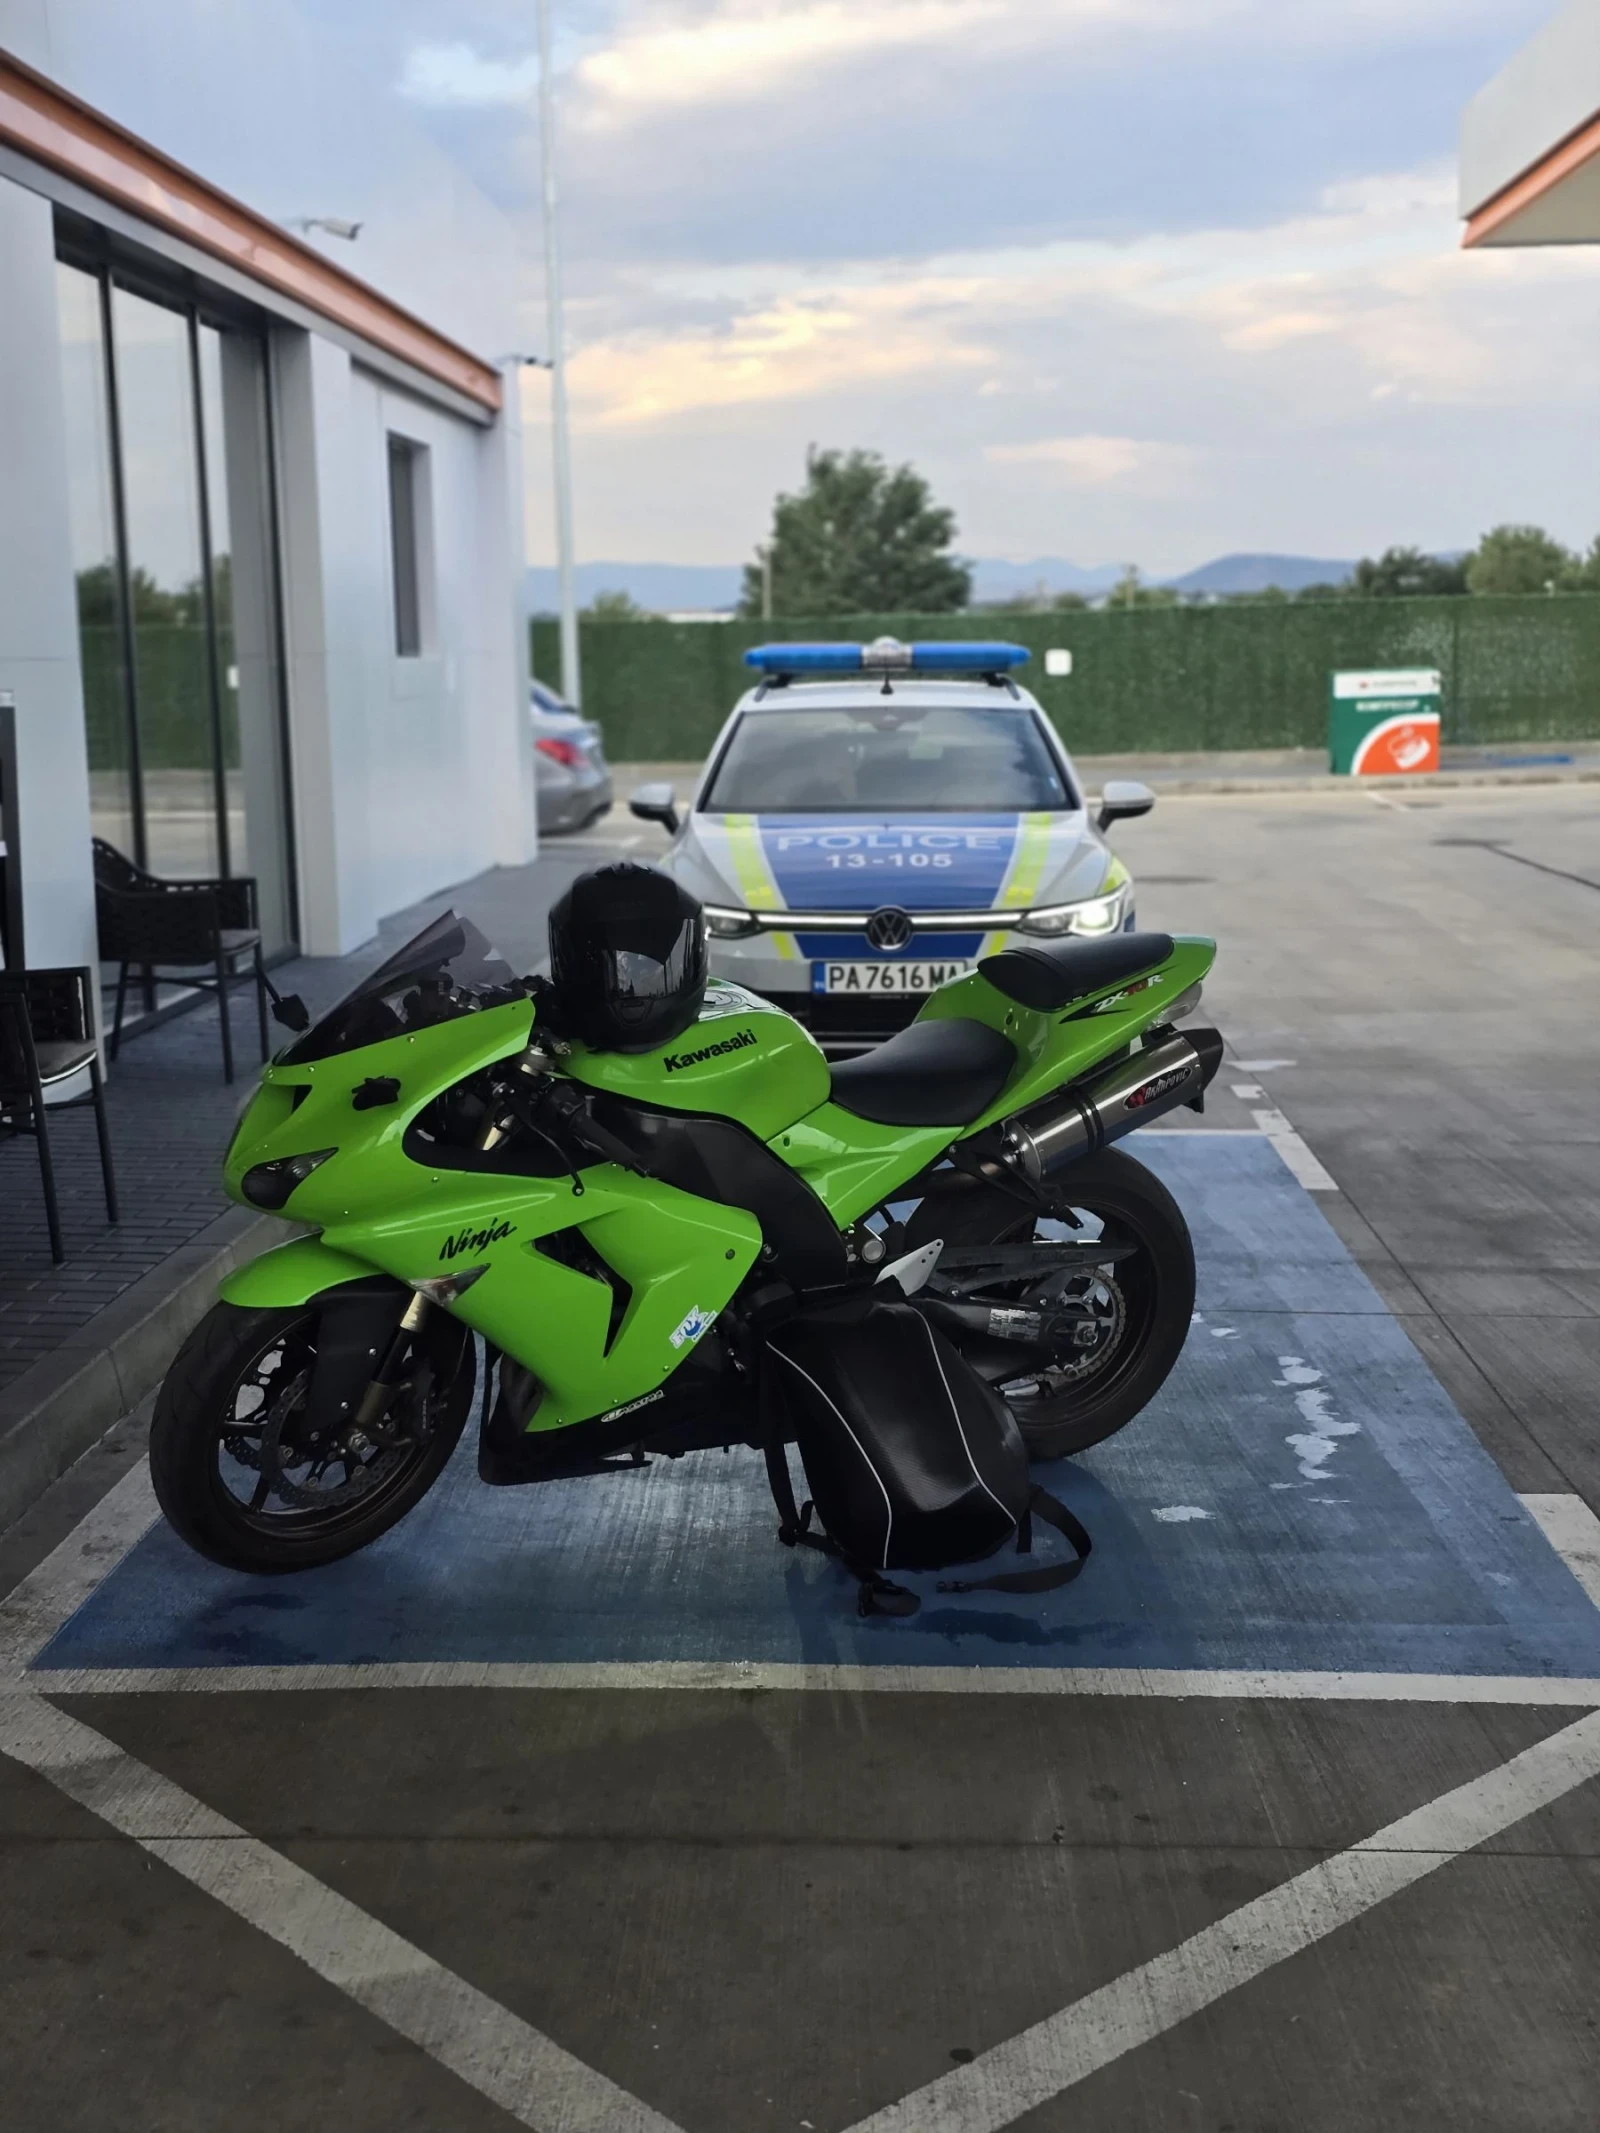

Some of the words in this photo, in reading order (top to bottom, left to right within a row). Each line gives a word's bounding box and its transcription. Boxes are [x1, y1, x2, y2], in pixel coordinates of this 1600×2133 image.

[777, 833, 1001, 850] POLICE
[826, 853, 953, 868] 13-105
[866, 965, 924, 989] 7616
[663, 1028, 758, 1073] Kawasaki
[438, 1217, 518, 1261] Ninja
